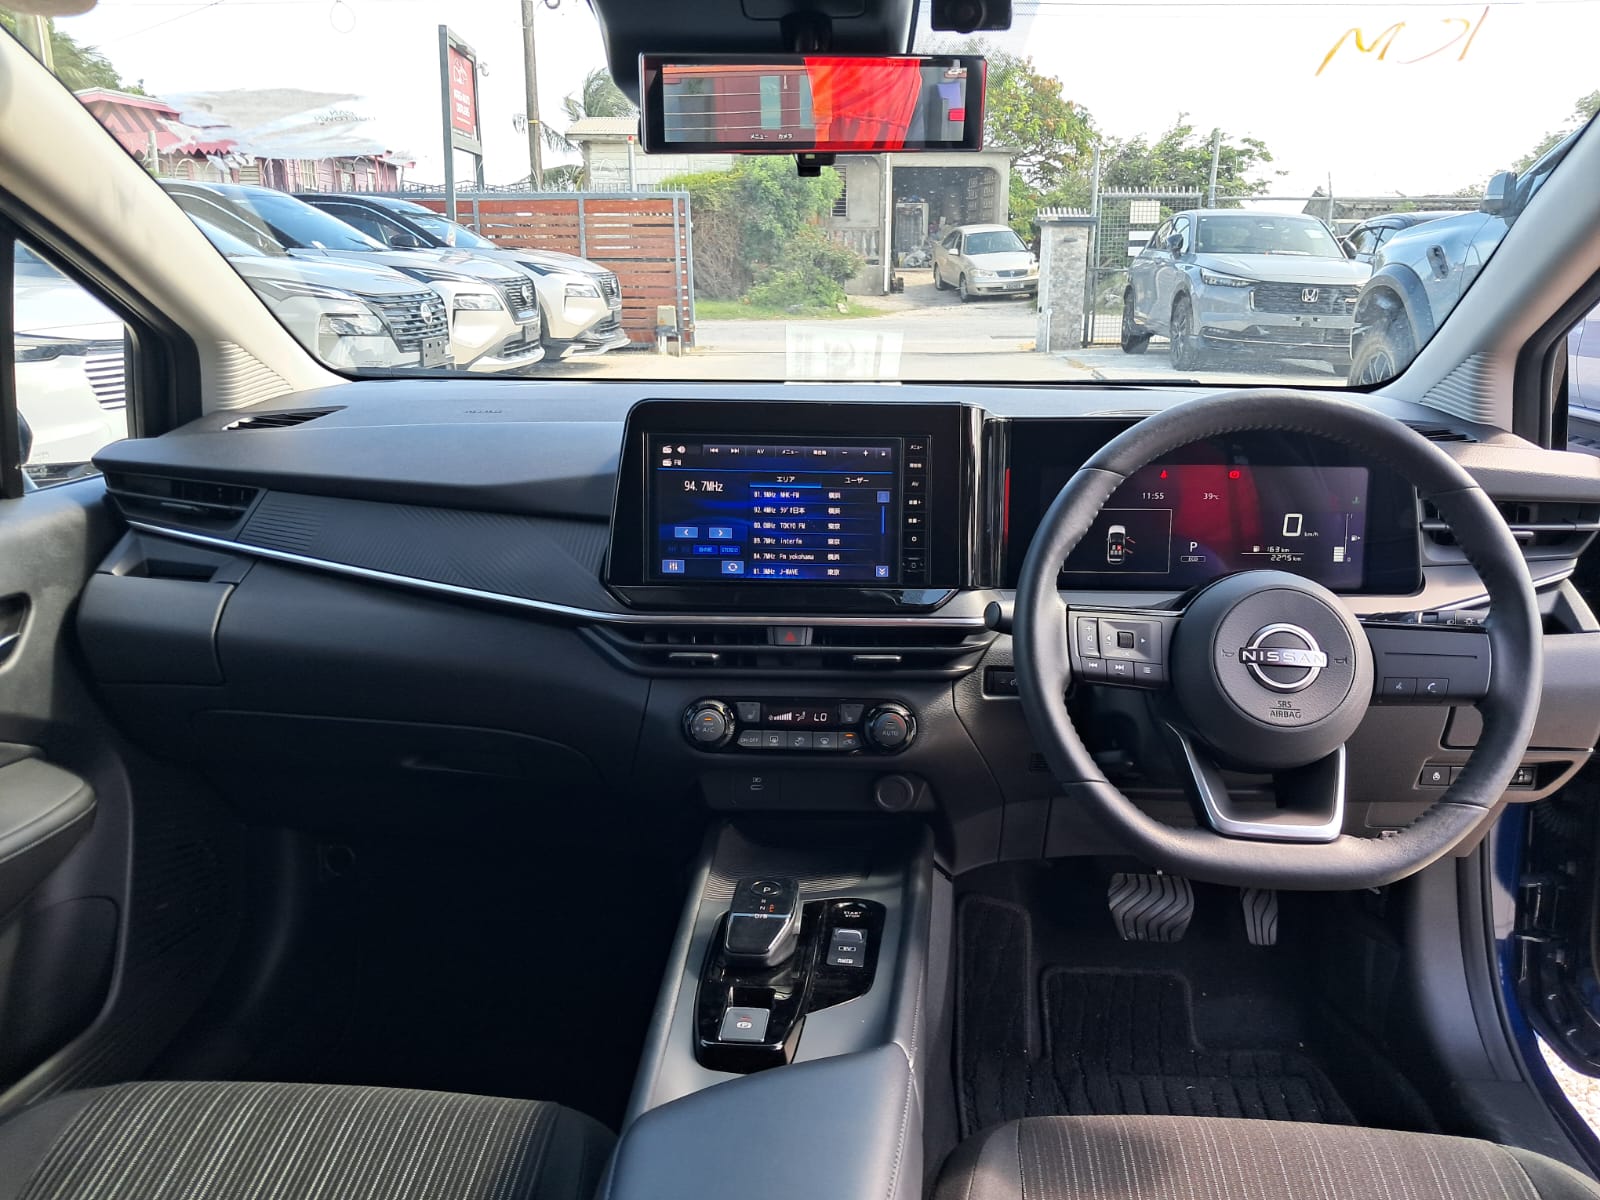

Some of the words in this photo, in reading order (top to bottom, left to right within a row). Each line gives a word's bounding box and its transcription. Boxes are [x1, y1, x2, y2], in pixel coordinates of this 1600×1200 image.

[1142, 492, 1165, 500] 11:55
[1282, 513, 1303, 537] 0
[1189, 541, 1198, 553] P
[1242, 650, 1325, 664] NISSAN
[1277, 700, 1292, 708] SRS
[813, 712, 828, 722] LO
[1269, 710, 1301, 719] AIRBAG
